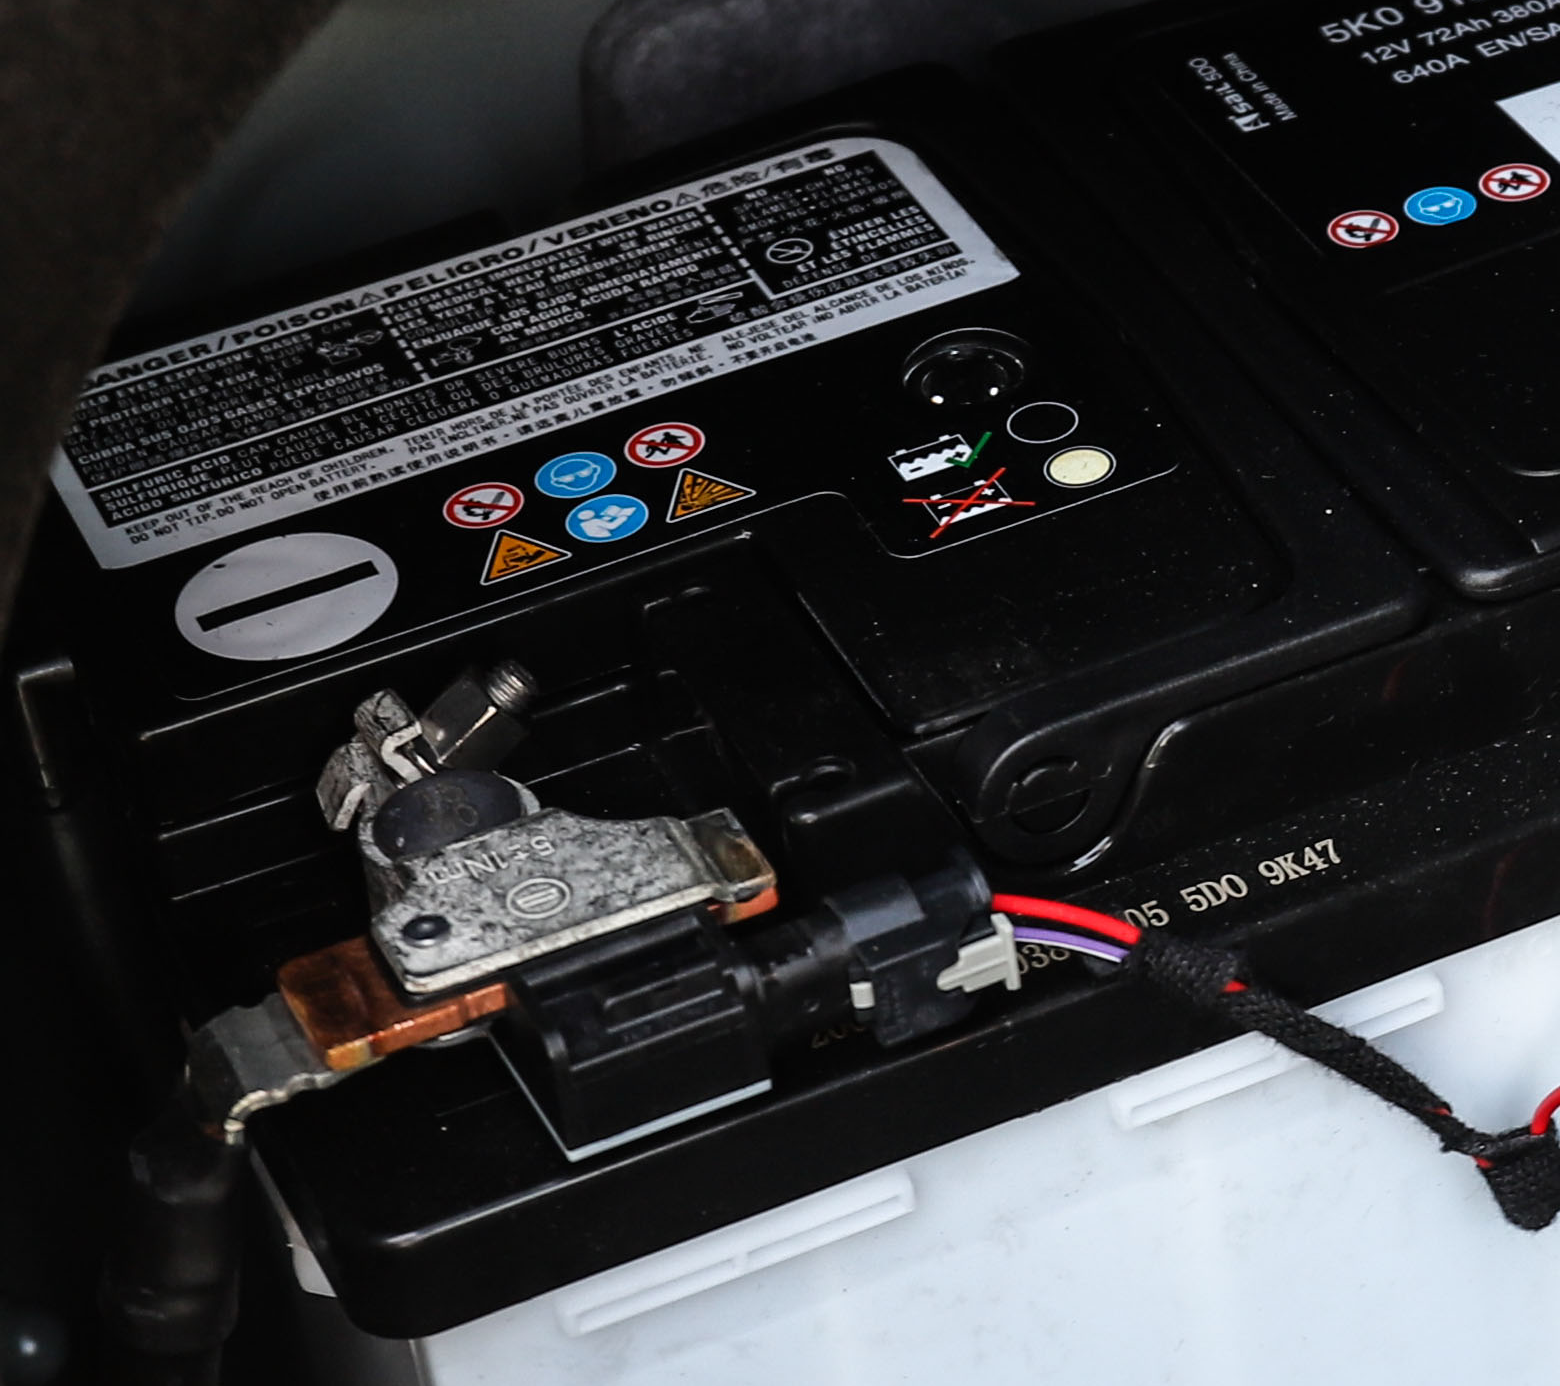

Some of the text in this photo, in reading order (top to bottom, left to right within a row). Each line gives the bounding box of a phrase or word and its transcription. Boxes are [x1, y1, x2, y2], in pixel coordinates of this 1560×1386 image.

[1319, 6, 1405, 44] 5K0
[1360, 39, 1412, 65] 12V
[1417, 17, 1492, 47] 72Ah
[1223, 52, 1259, 83] China
[1392, 53, 1470, 85] 640A
[1262, 91, 1299, 121] Made
[885, 201, 922, 221] LES
[485, 241, 597, 282] IMMEDIATELY
[595, 227, 641, 248] WITH
[640, 208, 699, 233] WATER
[793, 220, 937, 273] ET LES FLAMMES
[425, 282, 499, 312] MEDICAL
[496, 304, 533, 323] LOS
[723, 338, 747, 352] NO
[746, 317, 810, 345] VOLTEAR
[834, 294, 882, 316] ABRIR
[880, 287, 904, 301] LA
[779, 307, 811, 324] DEL
[810, 287, 873, 314] ALCANCE
[872, 279, 896, 294] DE
[893, 270, 926, 287] LOS
[487, 317, 526, 337] CON
[161, 348, 255, 384] EXPLOSIVE
[256, 329, 313, 354] GASES
[137, 428, 174, 447] SUS
[174, 412, 223, 435] OJOS
[221, 394, 280, 420] GASES
[280, 360, 386, 401] EXPLOSIVOS
[329, 422, 398, 452] CAUSAR
[402, 395, 482, 428] CEGUERA
[617, 326, 697, 359] FUERTES
[401, 425, 447, 447] TENIR
[447, 412, 486, 432] HORS
[486, 405, 508, 420] DE
[508, 398, 532, 412] LA
[585, 371, 615, 387] DES
[685, 341, 708, 355] NE
[406, 438, 437, 456] PAS
[531, 398, 561, 415] PAS
[560, 380, 617, 406] OUVRIR
[615, 373, 639, 388] LA
[97, 467, 186, 504] SULFURIC
[186, 452, 234, 475] ACID
[233, 440, 272, 460] CAN
[274, 420, 332, 447] CAUSE
[337, 386, 438, 426] BLINDNESS
[440, 377, 469, 393] OR
[471, 354, 539, 383] SEVERE
[543, 333, 604, 360] BURNS
[270, 429, 340, 460] CAUSER
[446, 386, 475, 403] OU
[123, 516, 163, 537] KEEP
[162, 507, 193, 525] OUT
[194, 499, 217, 514] OF
[218, 489, 248, 506] THE
[247, 474, 296, 497] REACH
[295, 466, 319, 481] OF
[151, 521, 181, 539] NOT
[236, 494, 267, 511] NOT
[268, 481, 307, 501] OPEN
[1257, 838, 1341, 885] 9K47
